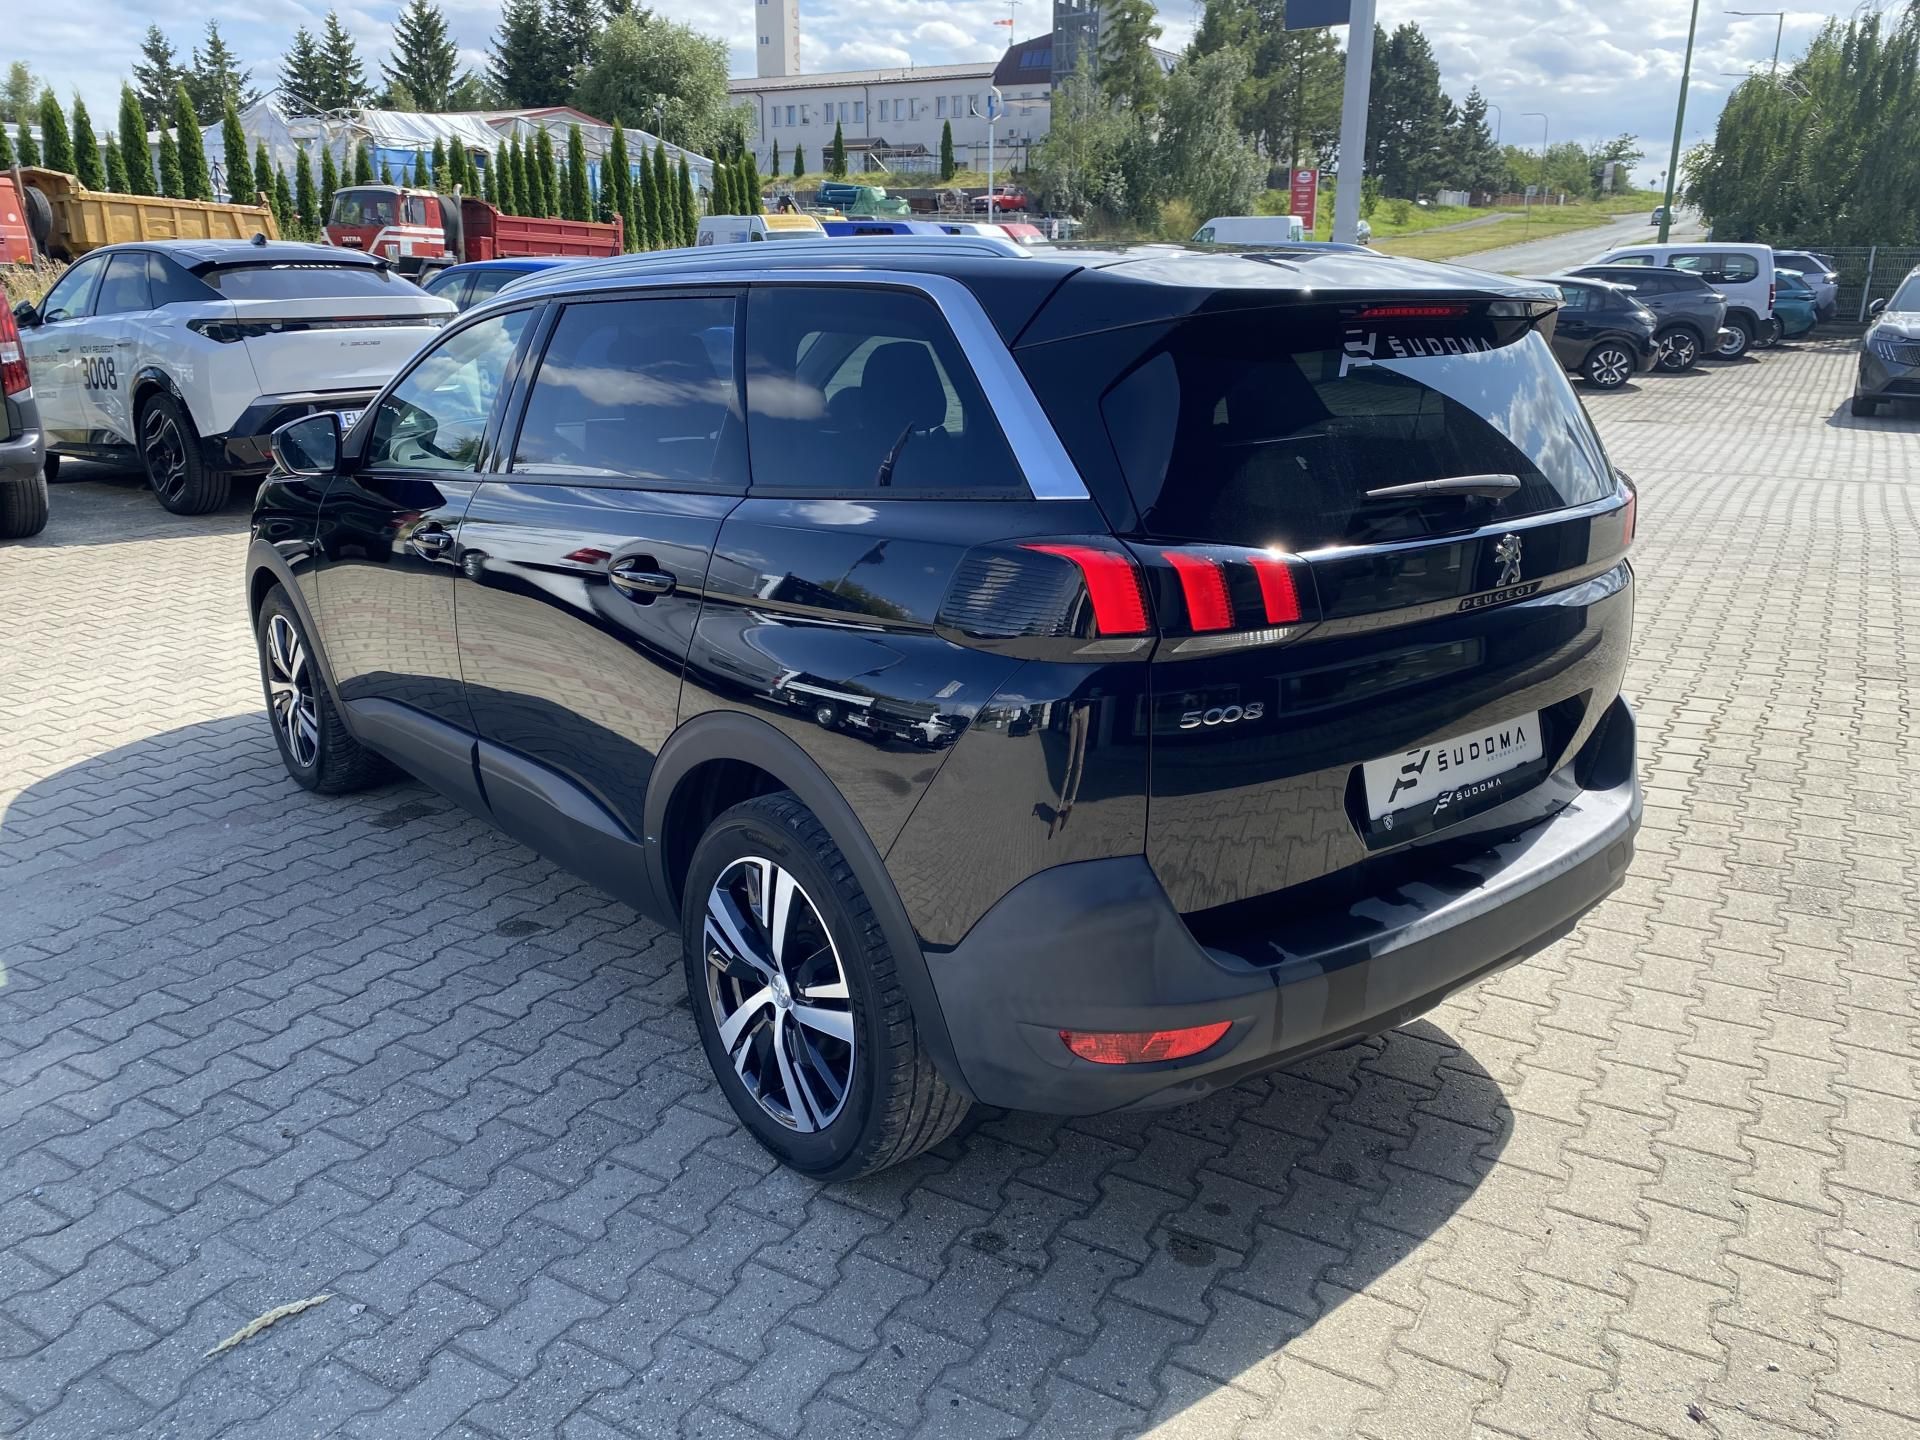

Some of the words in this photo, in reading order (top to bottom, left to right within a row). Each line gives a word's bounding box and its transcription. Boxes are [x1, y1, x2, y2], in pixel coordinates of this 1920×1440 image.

[1388, 335, 1494, 358] ŠUDOMA
[81, 356, 118, 390] 3008
[1461, 584, 1534, 610] PEUGEOT
[1179, 701, 1265, 729] 5008
[1437, 726, 1526, 772] ŠUDOMA
[1456, 777, 1502, 801] ŠUDOMA
